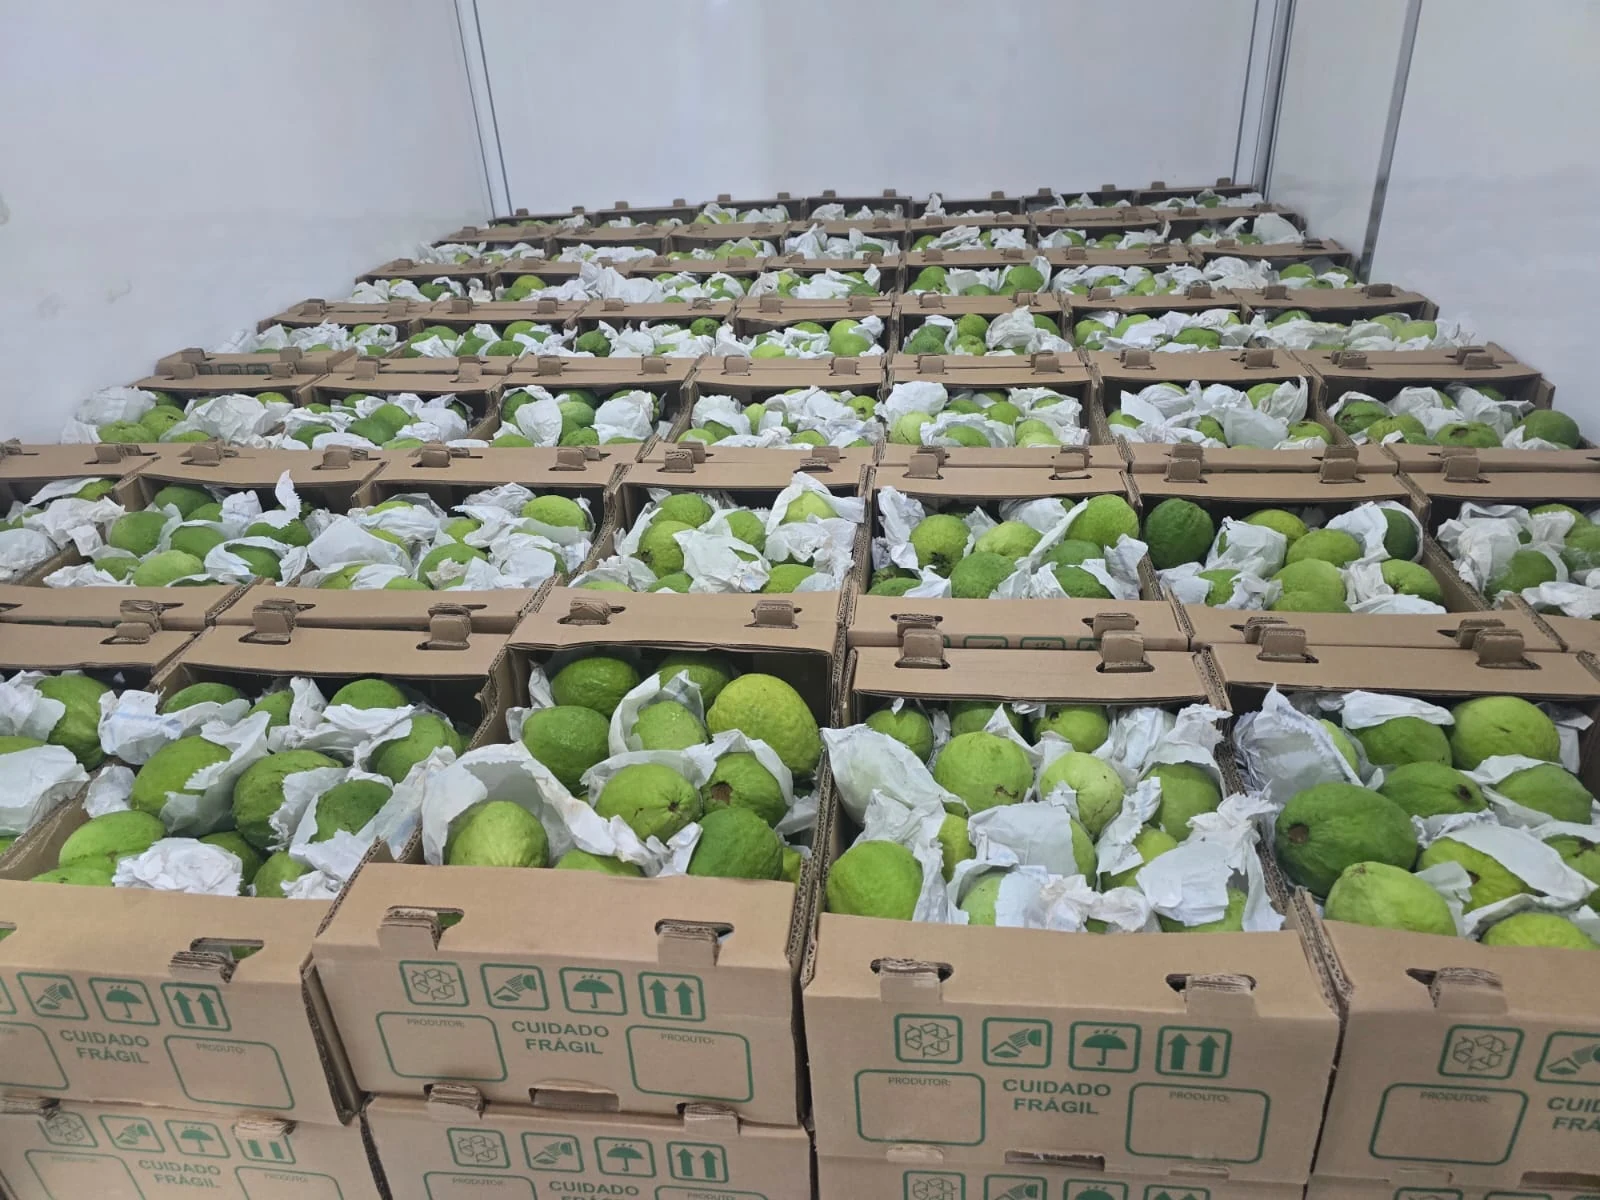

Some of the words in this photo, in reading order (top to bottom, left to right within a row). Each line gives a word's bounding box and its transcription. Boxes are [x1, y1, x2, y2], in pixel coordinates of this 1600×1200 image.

[407, 1018, 465, 1028] PRODUTOR:
[511, 1020, 609, 1039] CUIDADO
[59, 1029, 149, 1048] CUIDADO
[525, 1036, 604, 1055] FRÁGIL
[661, 1032, 715, 1045] PRODUTO:
[75, 1045, 150, 1064] FRÁGIL
[888, 1075, 951, 1087] PRODUTOR:
[1002, 1078, 1112, 1098] CUIDADO
[1169, 1090, 1230, 1103] PRODUTO:
[1013, 1096, 1100, 1115] FRÁGIL
[138, 1159, 222, 1176] CUIDADO
[153, 1173, 222, 1189] FRÁGIL
[549, 1180, 640, 1197] CUIDADO
